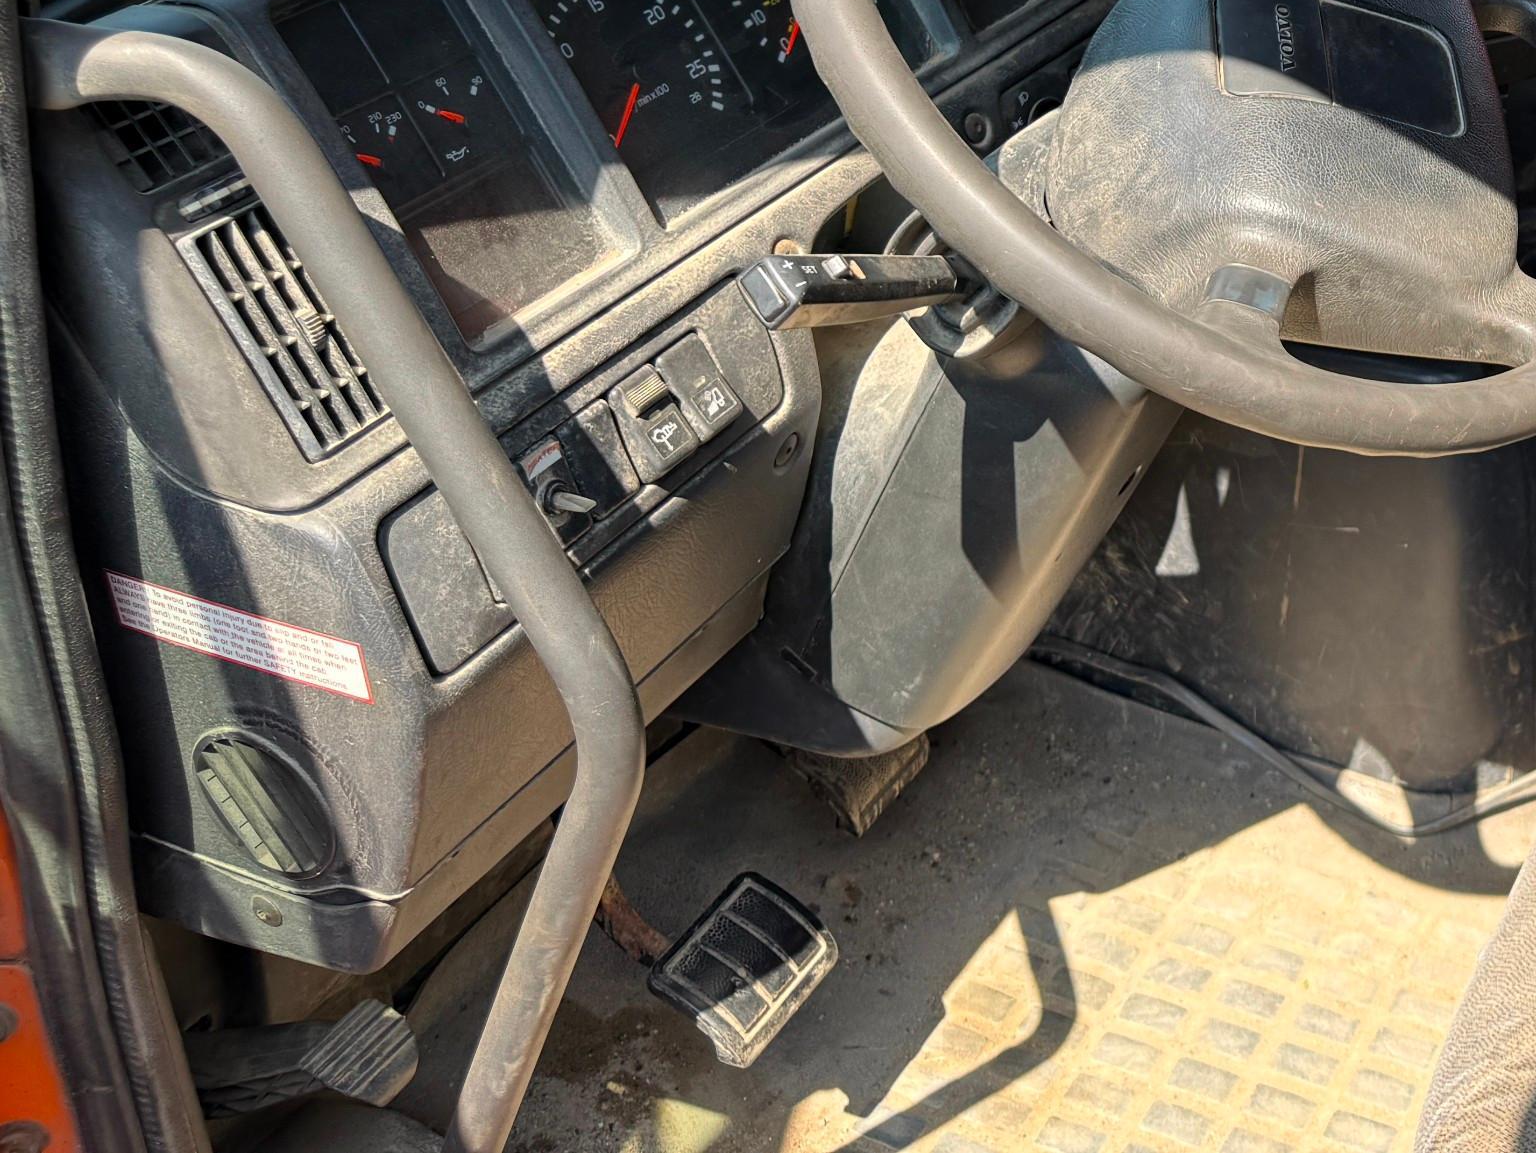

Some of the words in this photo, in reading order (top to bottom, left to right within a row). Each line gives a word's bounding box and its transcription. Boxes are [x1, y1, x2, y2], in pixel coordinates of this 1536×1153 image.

[643, 5, 666, 26] 20
[750, 8, 767, 26] 10
[1275, 3, 1297, 73] VOLVO
[685, 59, 707, 80] 25
[368, 111, 383, 124] 210
[385, 111, 402, 125] 230
[801, 265, 818, 274] SET
[113, 586, 145, 602] ALWAYS
[168, 604, 187, 615] three
[189, 611, 210, 622] limbs
[214, 618, 231, 629] (one
[233, 624, 248, 633] foot
[251, 629, 266, 638] and
[269, 634, 282, 643] two
[285, 639, 310, 652] hands
[324, 651, 339, 660] two
[341, 656, 357, 665] feet
[162, 593, 183, 605] avoid
[186, 600, 220, 617] personal
[222, 612, 244, 624] injury
[246, 619, 262, 628] due
[292, 632, 308, 641] and
[116, 597, 130, 606] and
[132, 603, 146, 611] one
[182, 617, 211, 631] contact
[213, 627, 229, 636] with
[231, 633, 244, 641] the
[246, 637, 274, 650] vehicle
[287, 649, 297, 657] all
[299, 653, 321, 664] times
[324, 660, 347, 672] when
[119, 607, 150, 622] entering
[162, 620, 187, 634] exiting
[189, 629, 202, 637] the
[204, 633, 218, 642] cab
[230, 641, 243, 649] the
[246, 647, 263, 655] area
[266, 652, 293, 664] behind
[296, 660, 309, 669] the
[122, 615, 136, 625] See
[138, 620, 150, 629] the
[192, 638, 220, 651] Manual
[236, 652, 261, 664] further
[263, 660, 296, 674] SAFETY
